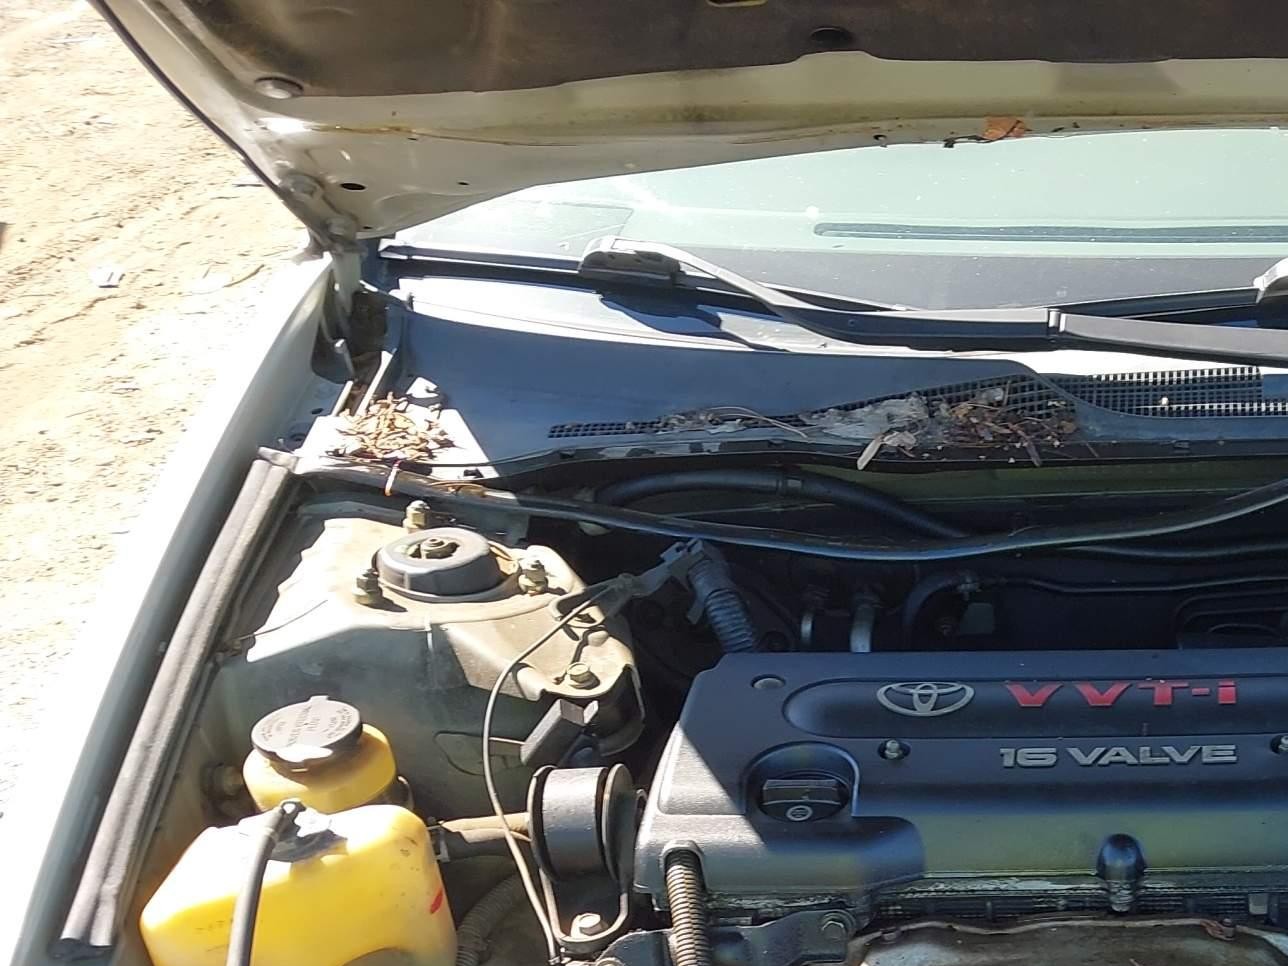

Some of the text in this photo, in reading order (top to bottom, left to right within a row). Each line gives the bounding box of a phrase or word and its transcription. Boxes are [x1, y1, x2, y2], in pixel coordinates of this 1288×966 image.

[1004, 680, 1237, 708] VVT-i
[1000, 743, 1238, 768] 16 VALVE
